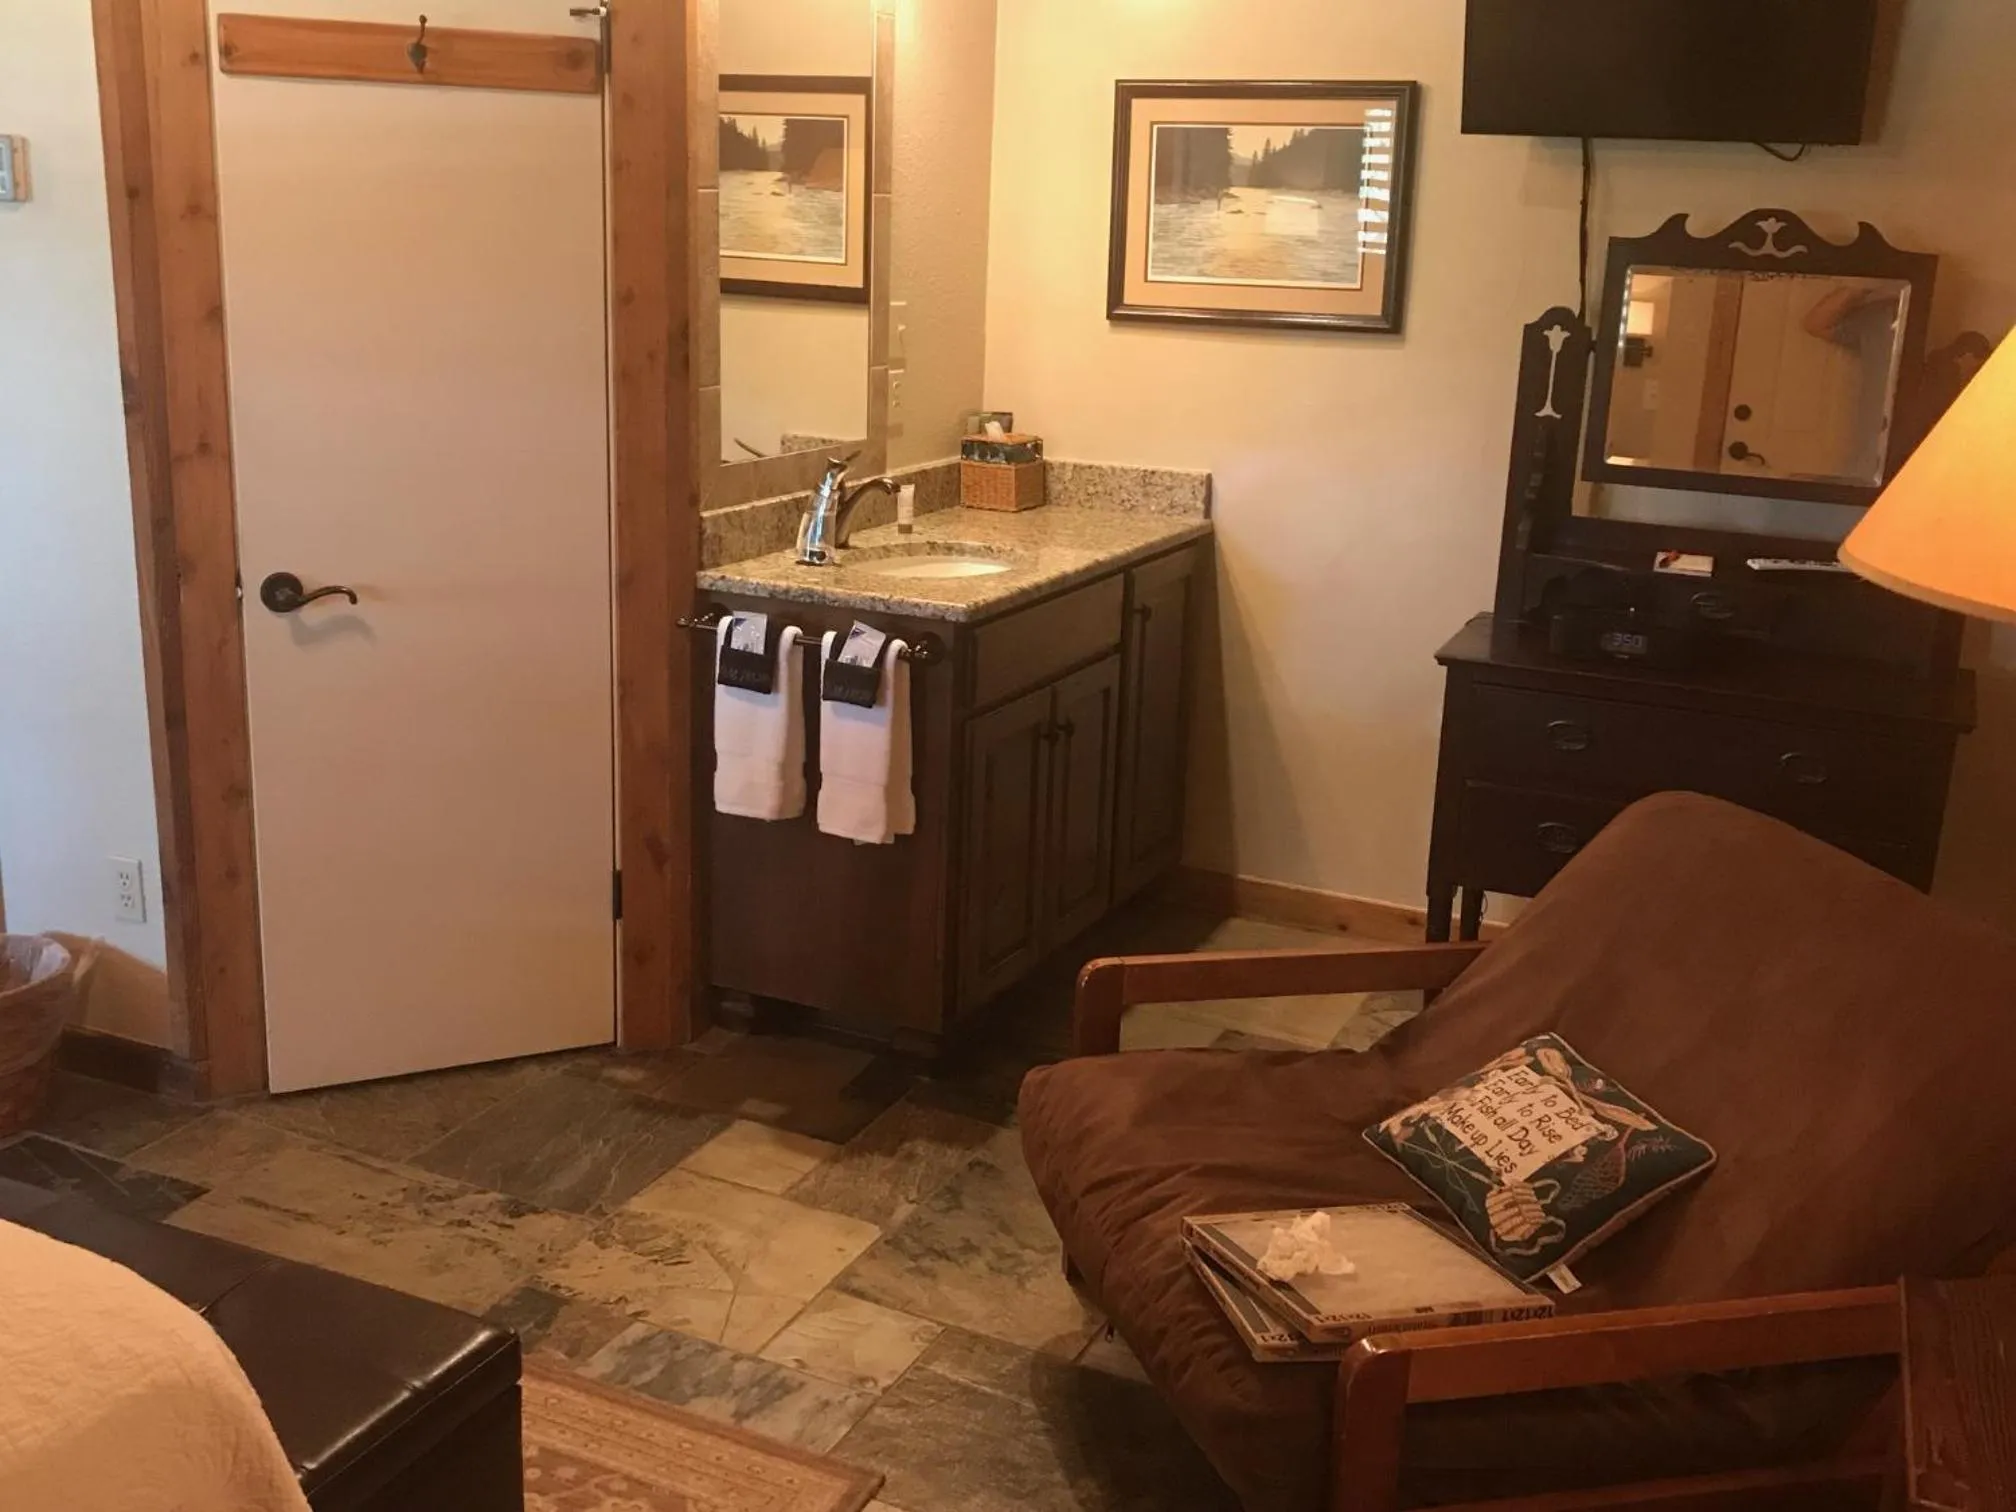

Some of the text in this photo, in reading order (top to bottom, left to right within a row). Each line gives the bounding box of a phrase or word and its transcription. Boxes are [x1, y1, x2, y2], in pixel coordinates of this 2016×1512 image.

[1470, 1095, 1541, 1157] Fish all Day
[1484, 1079, 1521, 1105] Early
[1530, 1114, 1563, 1144] Rise
[1507, 1070, 1543, 1094] Early
[1554, 1107, 1591, 1131] Bed
[1446, 1102, 1517, 1174] Make up Lies
